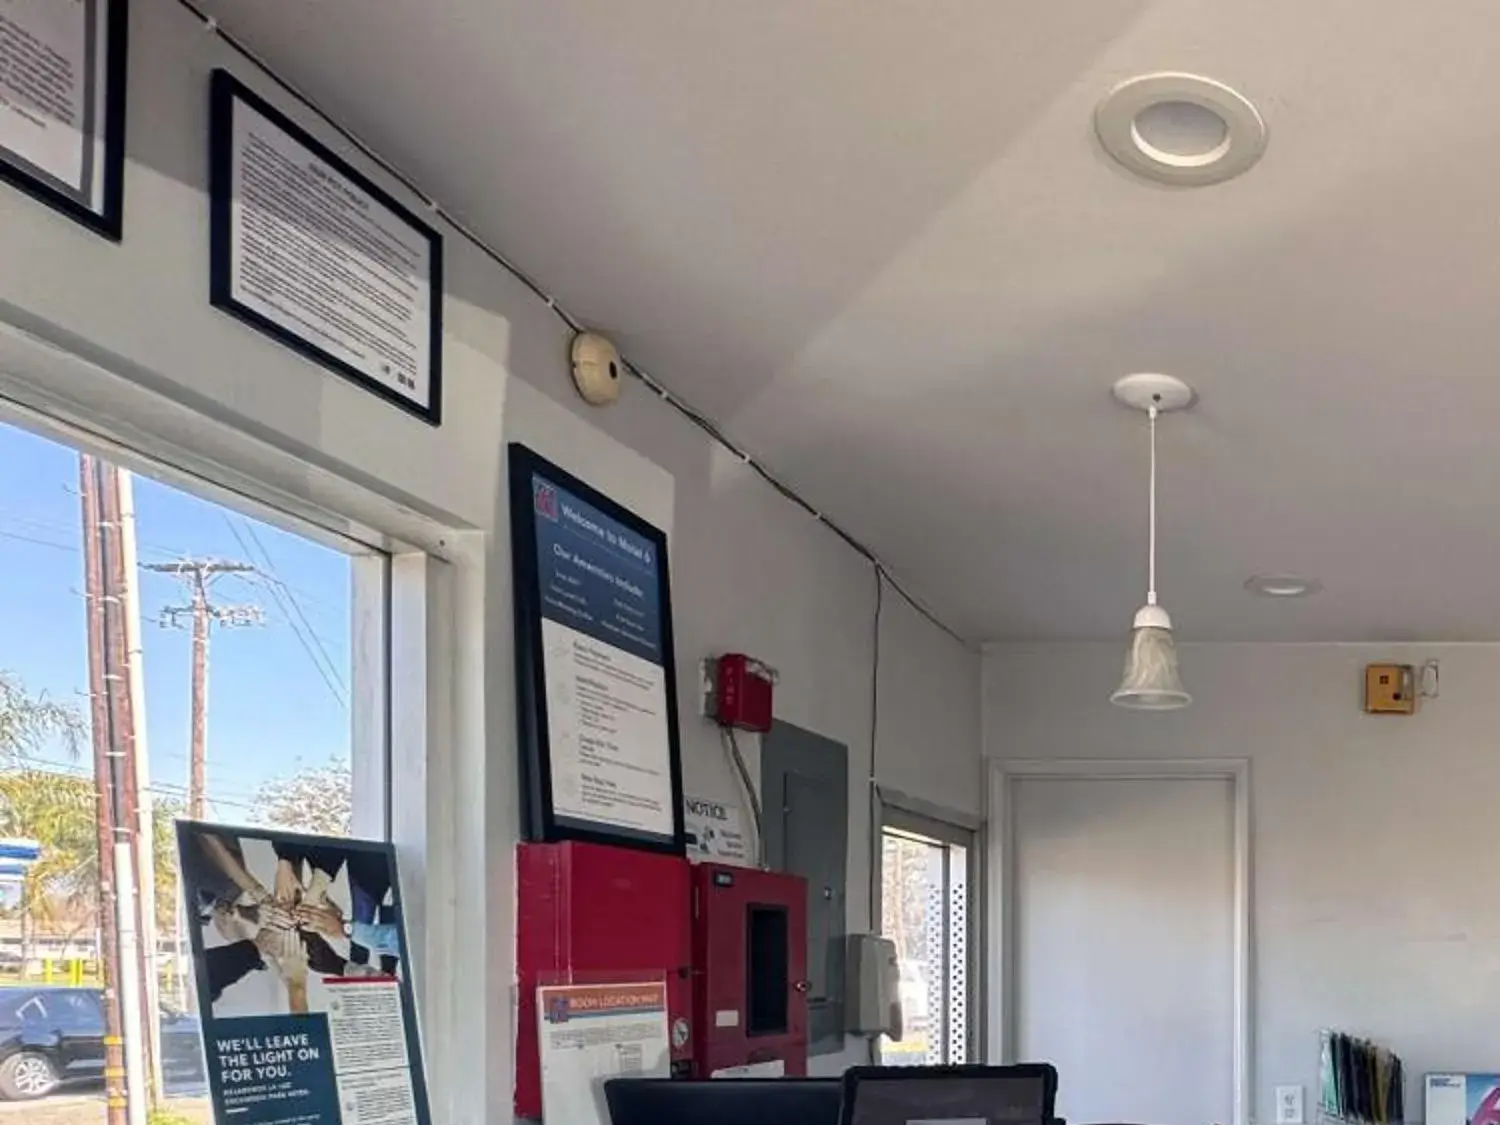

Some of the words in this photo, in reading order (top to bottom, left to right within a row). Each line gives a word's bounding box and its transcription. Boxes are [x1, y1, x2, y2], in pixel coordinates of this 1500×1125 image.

[216, 1037, 262, 1052] WE'LL
[265, 1033, 309, 1049] LEAVE
[219, 1053, 249, 1068] THE
[253, 1049, 294, 1065] LIGHT
[297, 1047, 319, 1061] ON
[221, 1068, 253, 1084] FOR
[255, 1064, 292, 1080] YOU.
